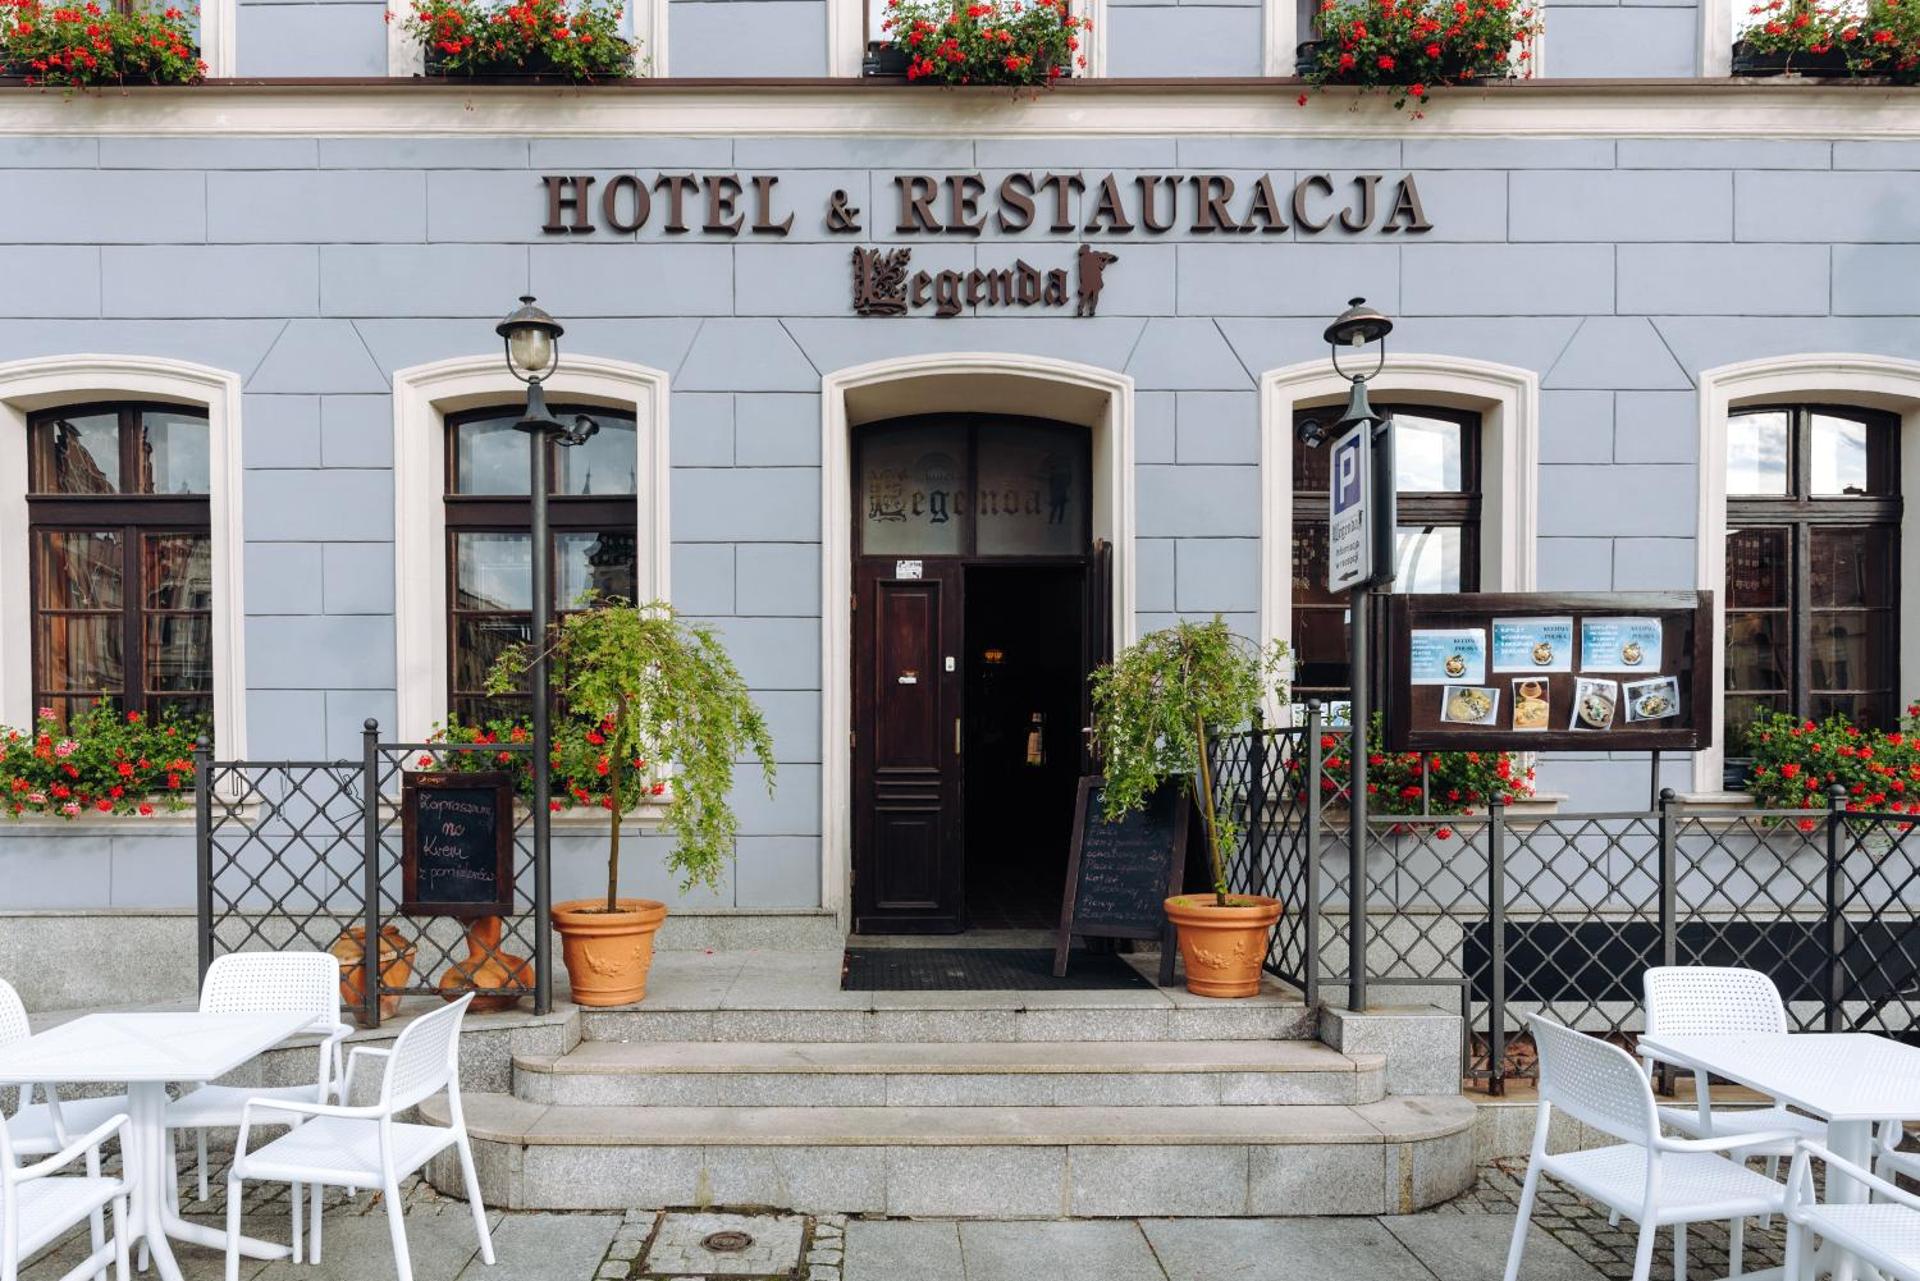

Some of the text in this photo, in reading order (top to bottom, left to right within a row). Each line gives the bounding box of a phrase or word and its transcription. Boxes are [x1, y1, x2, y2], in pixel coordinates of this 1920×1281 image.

[542, 171, 1435, 237] HOTEL & RESTAURACJA
[853, 245, 1071, 318] Legenda
[1340, 446, 1355, 504] P
